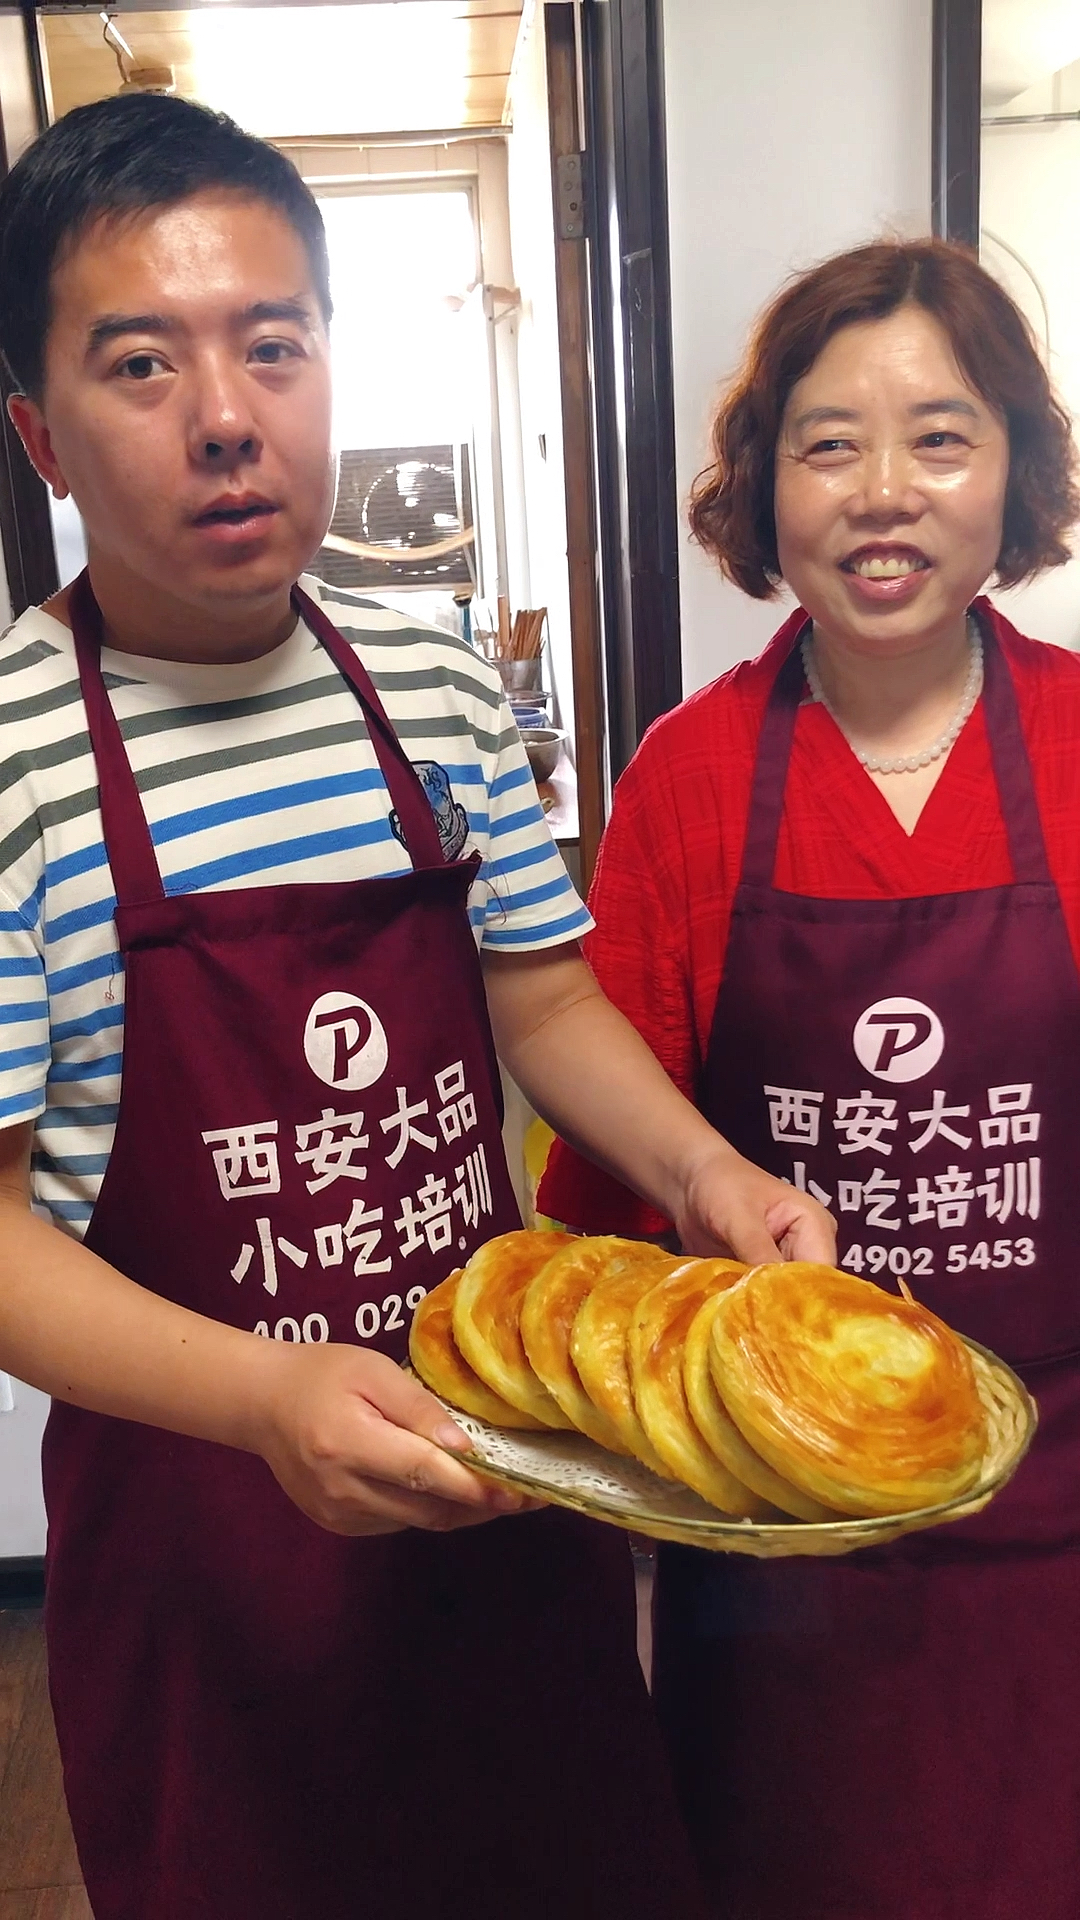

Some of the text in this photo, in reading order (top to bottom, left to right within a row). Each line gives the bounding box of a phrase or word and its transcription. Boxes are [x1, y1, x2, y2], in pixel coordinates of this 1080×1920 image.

[312, 1003, 374, 1084] P
[863, 1011, 933, 1073] P
[201, 1060, 478, 1202] 西安大品
[763, 1083, 1041, 1156] 西安大品
[230, 1143, 493, 1297] 小吃培训
[841, 1237, 1036, 1275] 4902 5453
